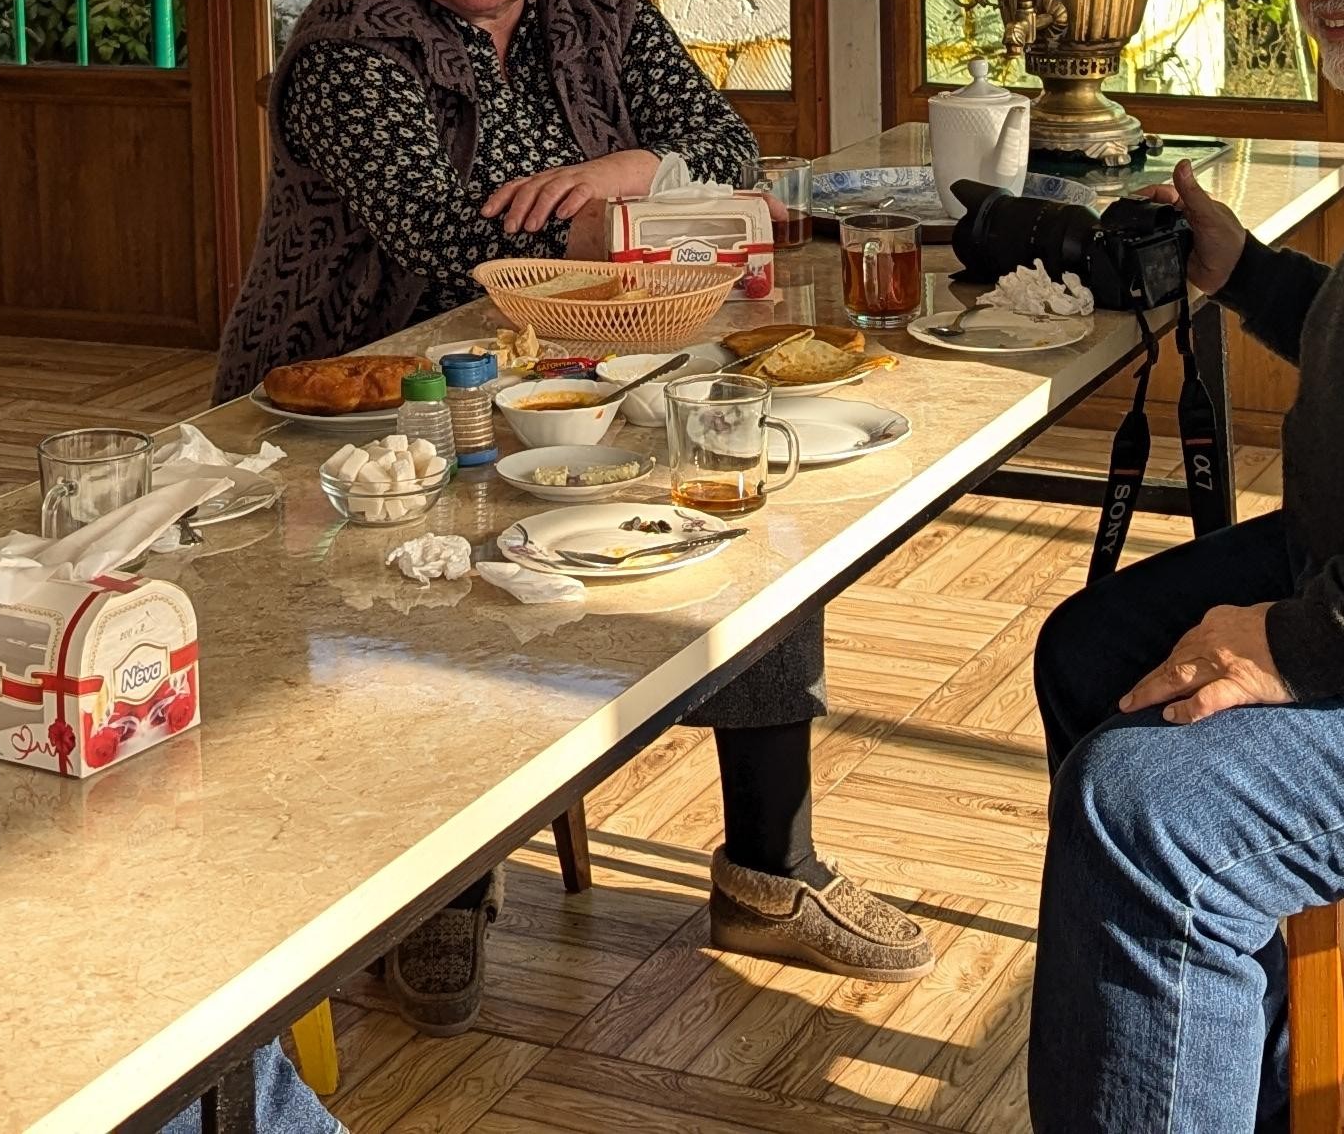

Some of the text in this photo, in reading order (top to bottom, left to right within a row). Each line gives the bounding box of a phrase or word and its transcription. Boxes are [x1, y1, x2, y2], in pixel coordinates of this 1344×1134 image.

[676, 248, 712, 263] Neva
[1100, 484, 1131, 555] SONY
[121, 660, 162, 693] Neva
